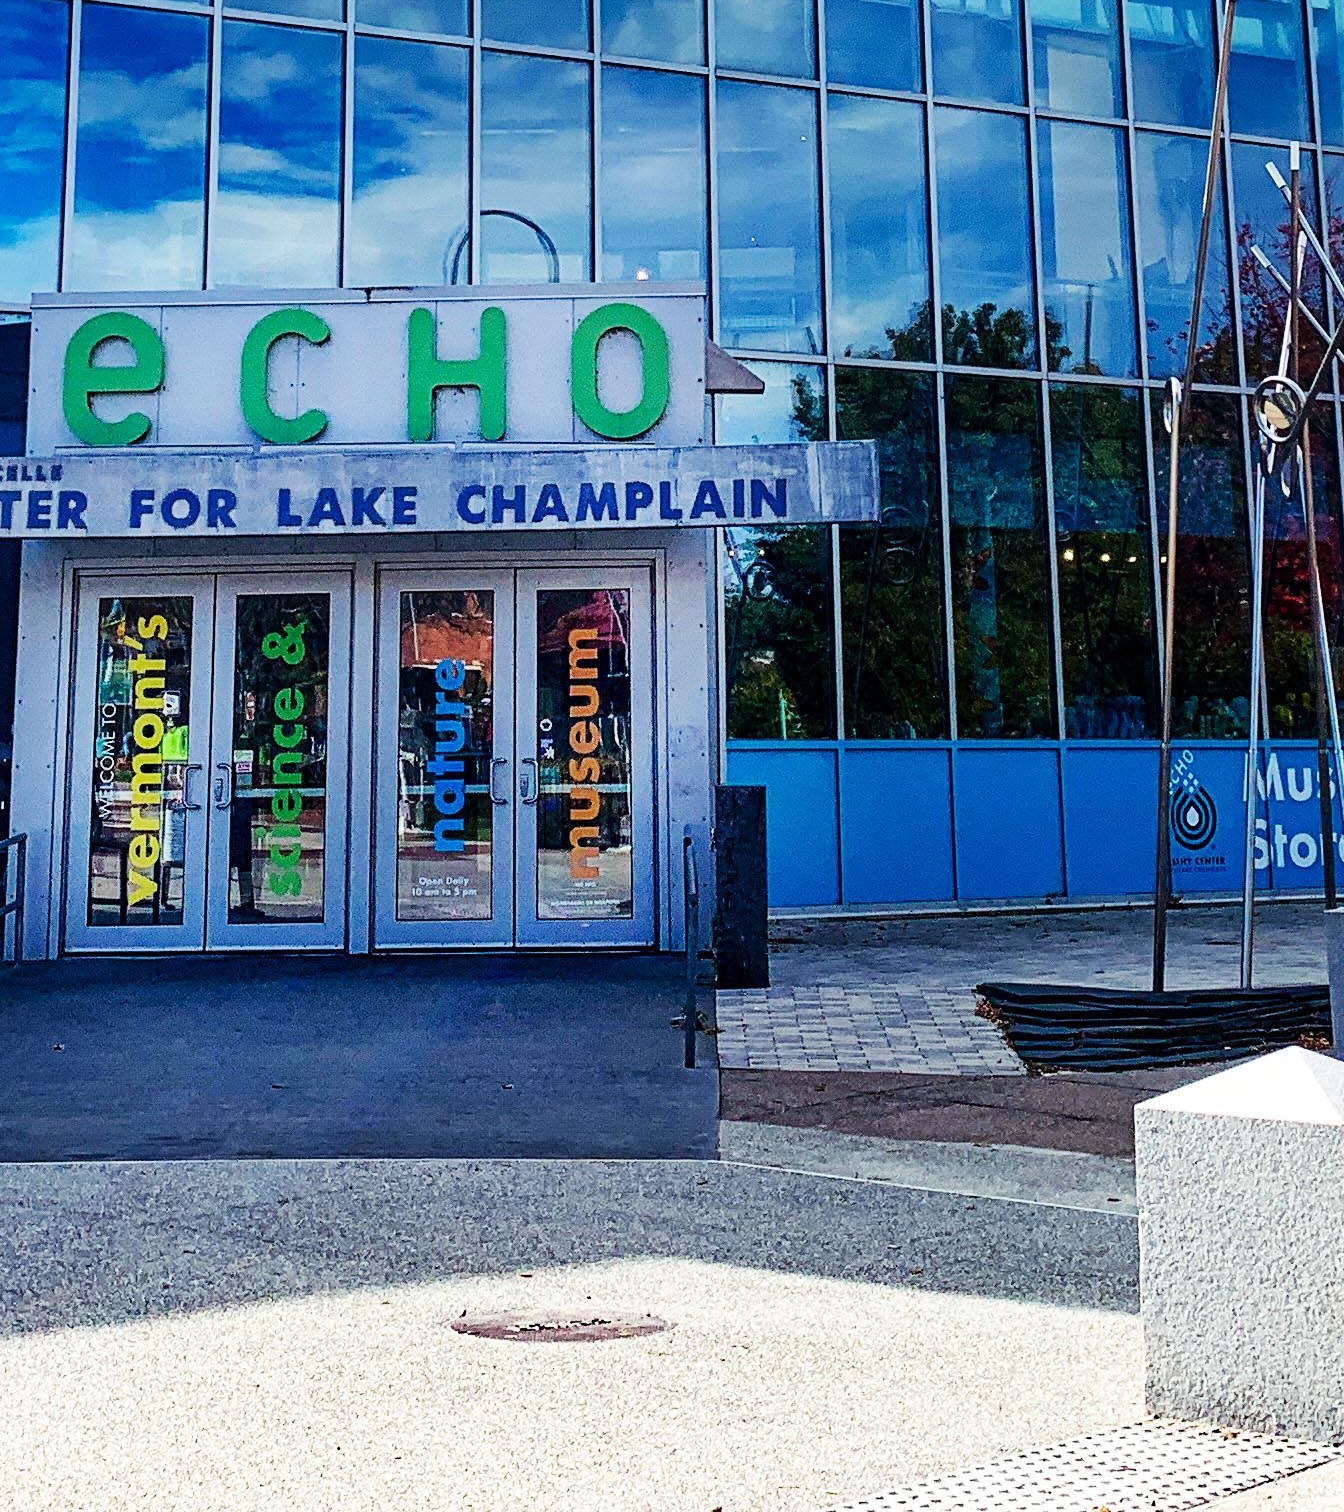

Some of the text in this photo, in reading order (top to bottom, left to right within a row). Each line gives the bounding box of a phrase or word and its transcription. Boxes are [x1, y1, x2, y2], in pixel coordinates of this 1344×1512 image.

[129, 488, 237, 529] FOR
[277, 486, 418, 528] LAKE
[455, 479, 788, 525] CHAMPLAIN
[98, 703, 117, 819] WELCOME TO
[123, 614, 169, 907] vermont's
[256, 616, 309, 898] science &
[426, 658, 466, 854] nature
[568, 628, 601, 880] museum
[418, 876, 444, 887] Open
